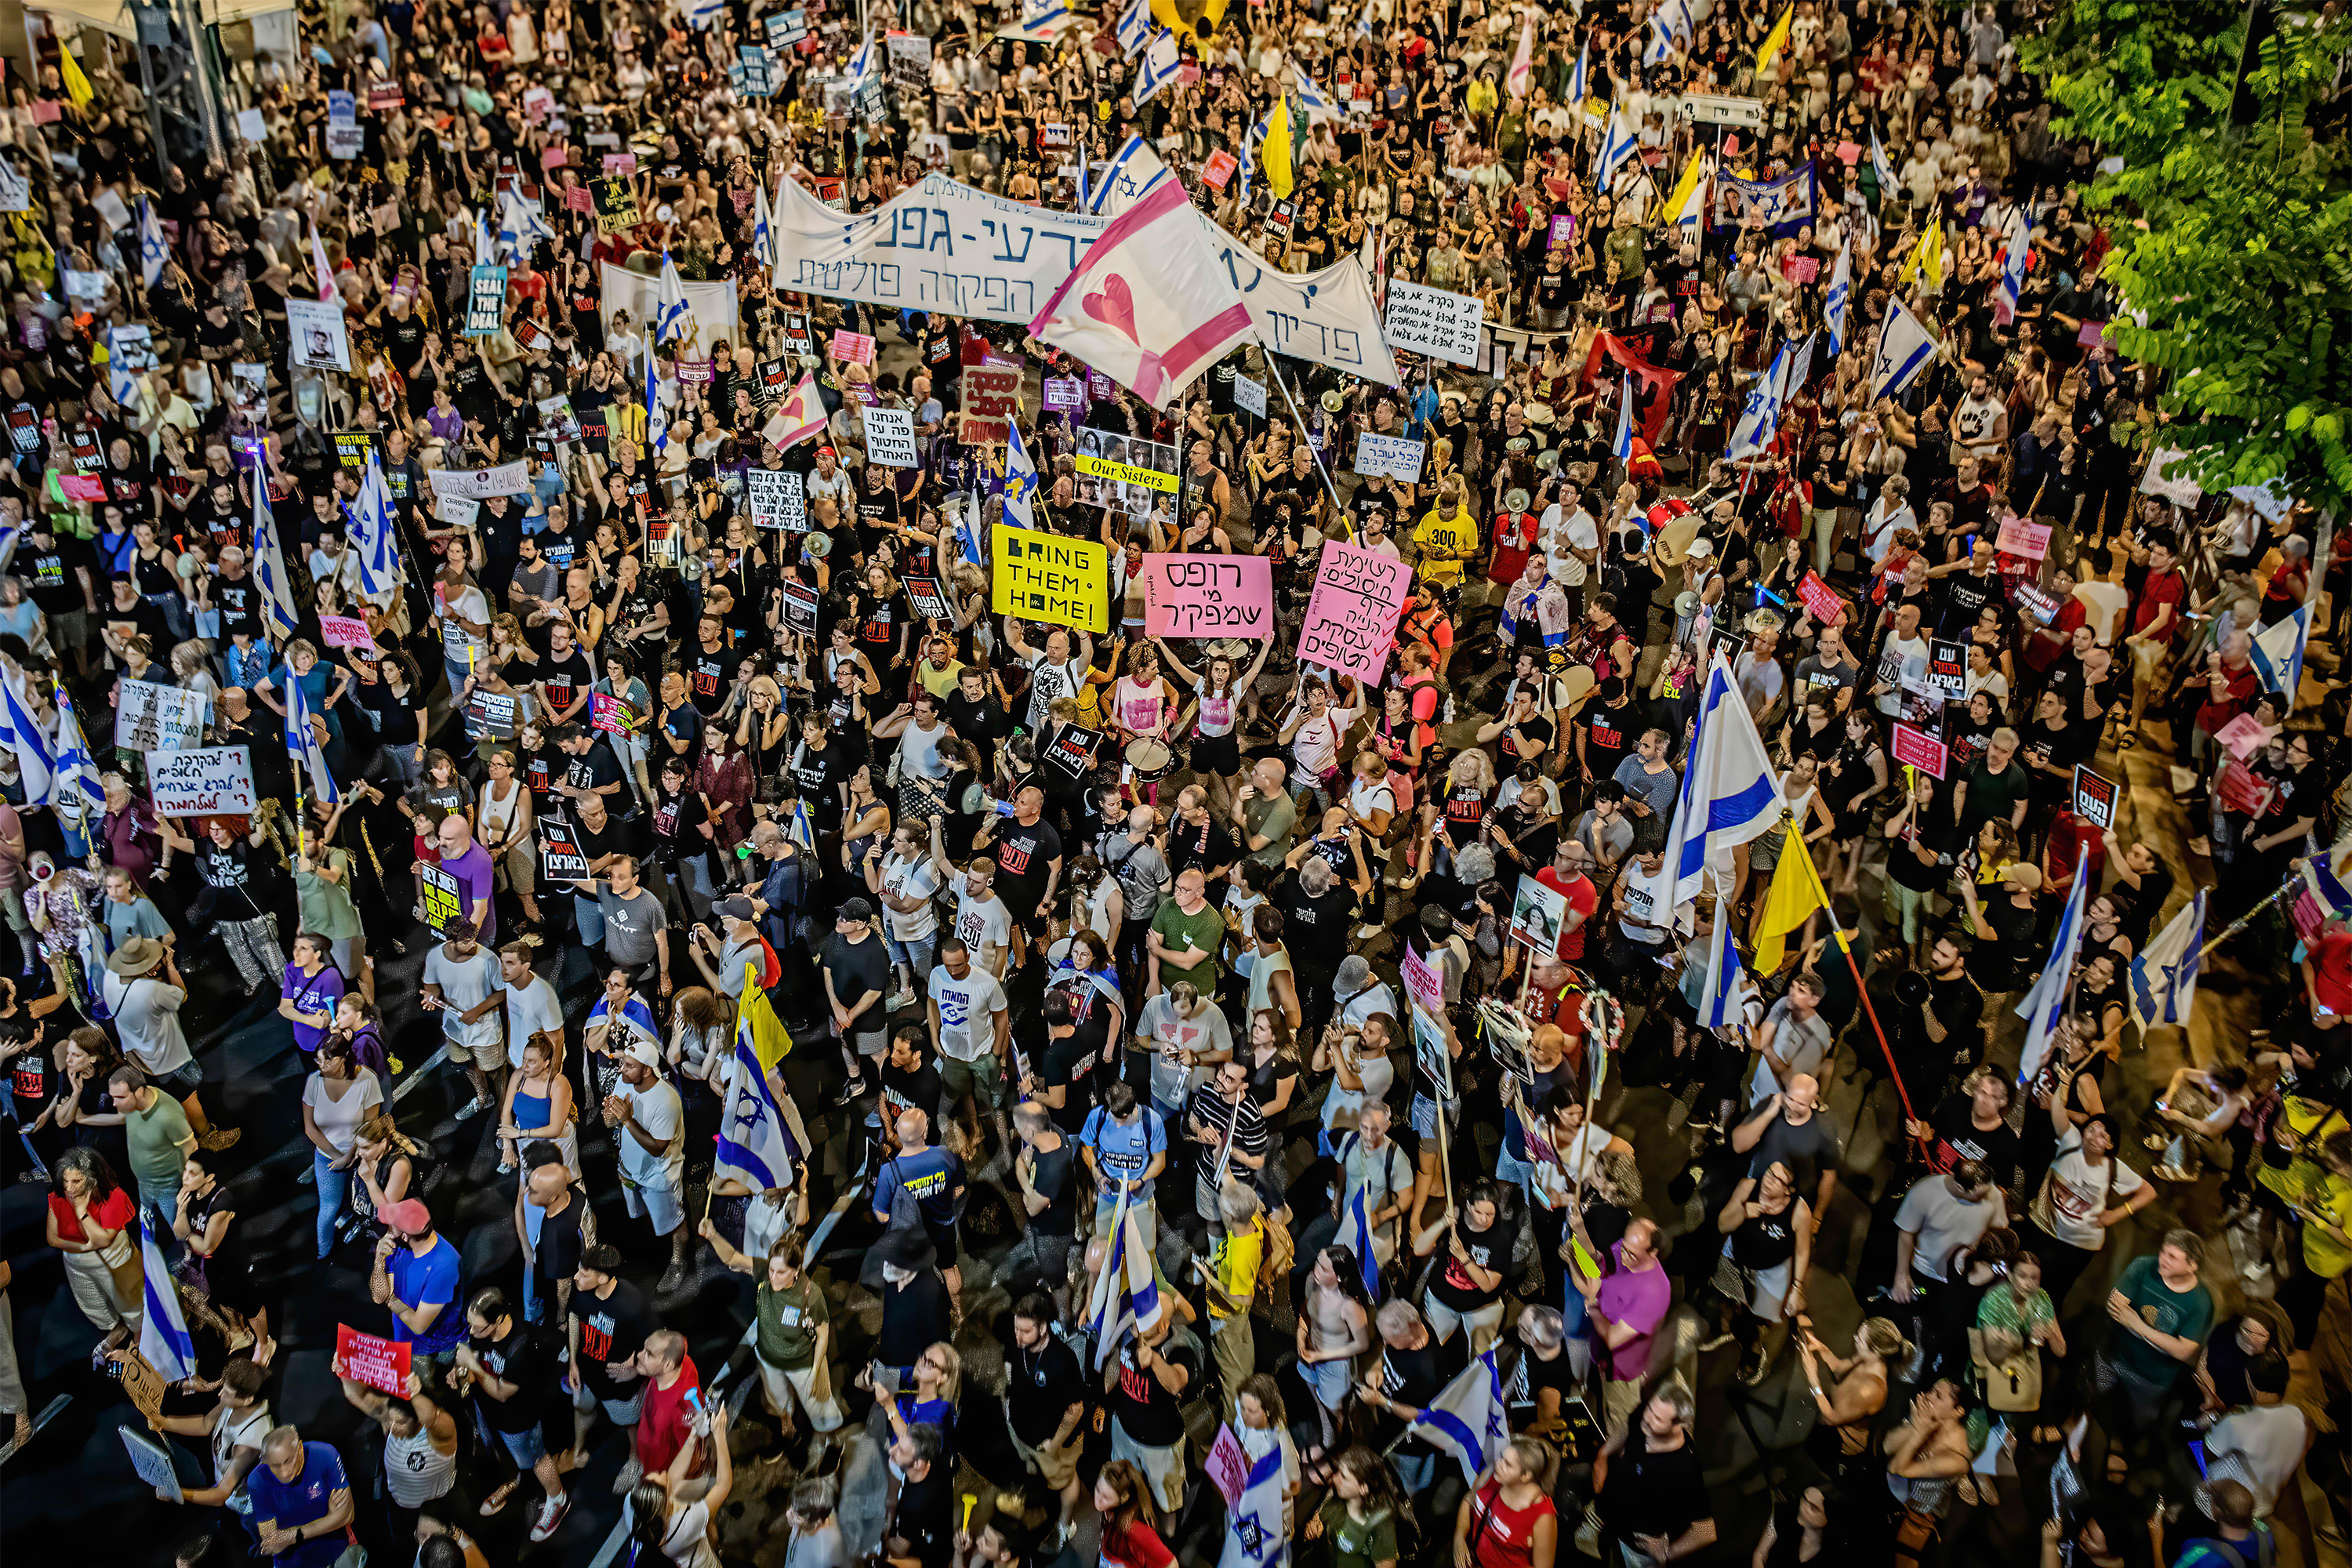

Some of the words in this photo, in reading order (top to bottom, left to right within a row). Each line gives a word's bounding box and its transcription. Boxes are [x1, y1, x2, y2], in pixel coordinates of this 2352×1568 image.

[792, 255, 901, 297] פוליטית
[474, 279, 502, 295] SEAL
[920, 269, 1033, 314] הפקרה
[1409, 292, 1422, 300] את
[1428, 295, 1454, 309] הקריב
[477, 296, 498, 311] THE
[1388, 303, 1419, 315] החטופים
[470, 311, 499, 328] DEAL
[1390, 317, 1418, 328] החטופים
[1266, 310, 1363, 365] פדיון
[1434, 325, 1455, 336] מקריב
[1460, 331, 1475, 342] ביבי
[1413, 334, 1428, 343] את
[1431, 335, 1454, 348] להציל
[871, 412, 903, 423] אנחנו
[868, 423, 884, 434] עד
[891, 426, 909, 435] פה
[334, 434, 372, 445] HOSTAGE
[871, 436, 910, 448] החטוף
[337, 445, 359, 455] DEAL
[871, 448, 913, 461] האחרון
[339, 456, 360, 466] NOW
[1091, 460, 1117, 476] Our
[1120, 466, 1163, 487] Sisters
[1007, 537, 1089, 570] BRING
[1329, 550, 1396, 583] רשימת
[1007, 563, 1079, 594] THEM
[1167, 562, 1241, 588] רופס
[1323, 568, 1391, 601] חיסולים:
[1203, 590, 1222, 602] מי
[1011, 589, 1093, 626] HOME!
[1360, 596, 1386, 616] דף
[1162, 604, 1261, 632] שמפקיר
[325, 621, 366, 633] WOMEN
[325, 627, 369, 639] DEMAND
[1310, 619, 1372, 649] עסקת
[339, 634, 361, 644] LIFE
[1305, 636, 1370, 671] חטופים
[1069, 731, 1089, 746] עם
[1061, 739, 1086, 757] חטוף
[1051, 745, 1083, 770] בארצו
[548, 827, 565, 841] עם
[548, 840, 576, 855] חטוף
[548, 854, 586, 870] בארצו
[1296, 907, 1316, 918] חופשי
